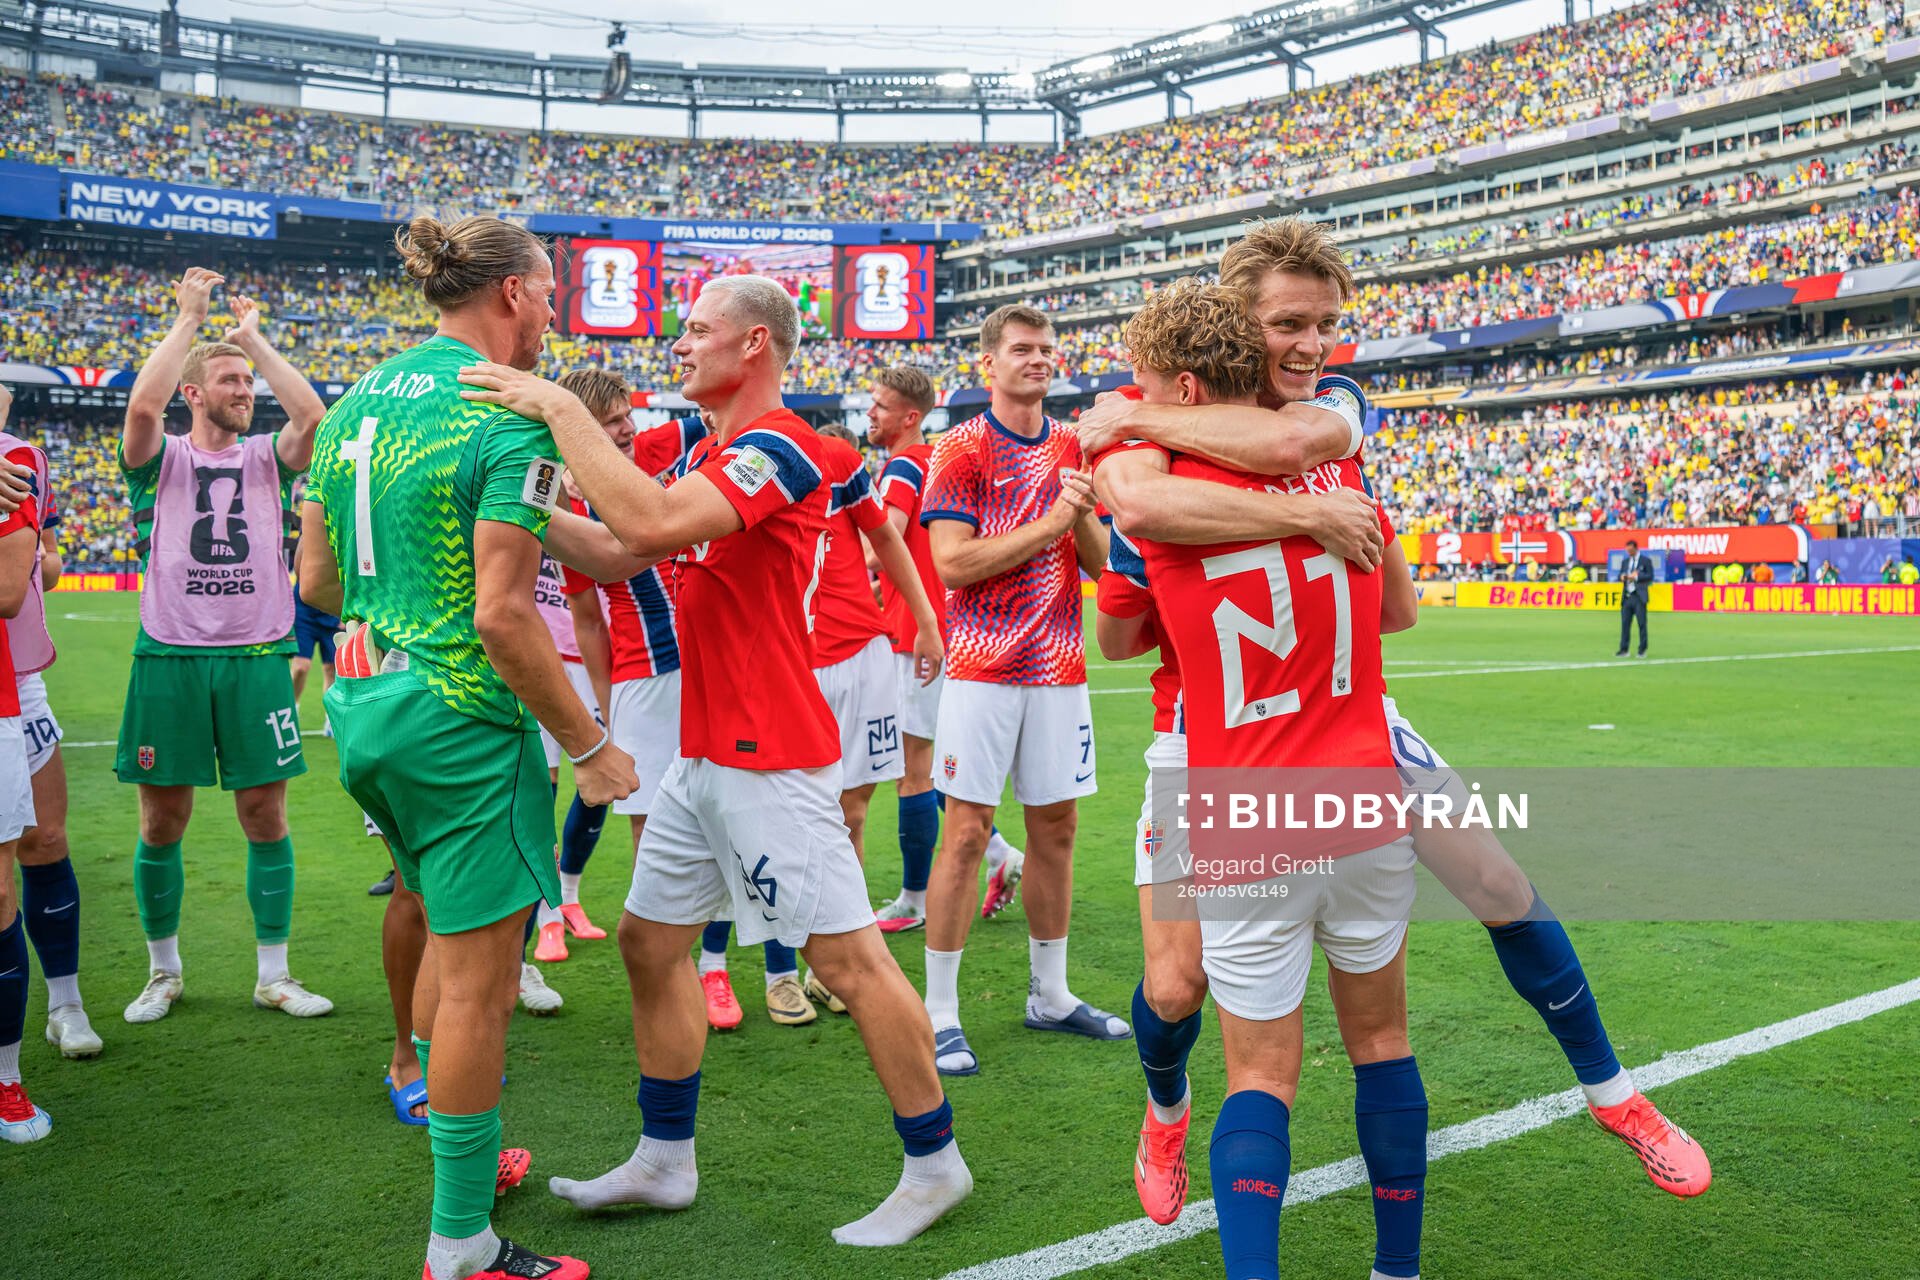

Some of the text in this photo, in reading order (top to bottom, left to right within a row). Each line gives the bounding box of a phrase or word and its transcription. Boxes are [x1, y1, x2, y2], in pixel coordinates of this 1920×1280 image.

[71, 181, 271, 220] NEW YORK
[70, 203, 270, 238] NEW JERSEY
[663, 225, 834, 242] FIFA WORLD CUP 2026
[340, 416, 377, 577] 1
[532, 496, 548, 506] 2026
[1436, 533, 1462, 564] 2
[1648, 533, 1729, 555] NORWAY
[185, 580, 255, 596] 2026
[187, 568, 253, 579] WORLD CUP
[1489, 585, 1622, 607] Be Active FIF
[1702, 586, 1915, 613] PLAY. MOVE. HAVE FUN!
[1201, 541, 1352, 729] 21
[24, 717, 60, 754] 19
[265, 707, 300, 750] 13
[867, 714, 898, 756] 25
[1079, 724, 1092, 764] 7
